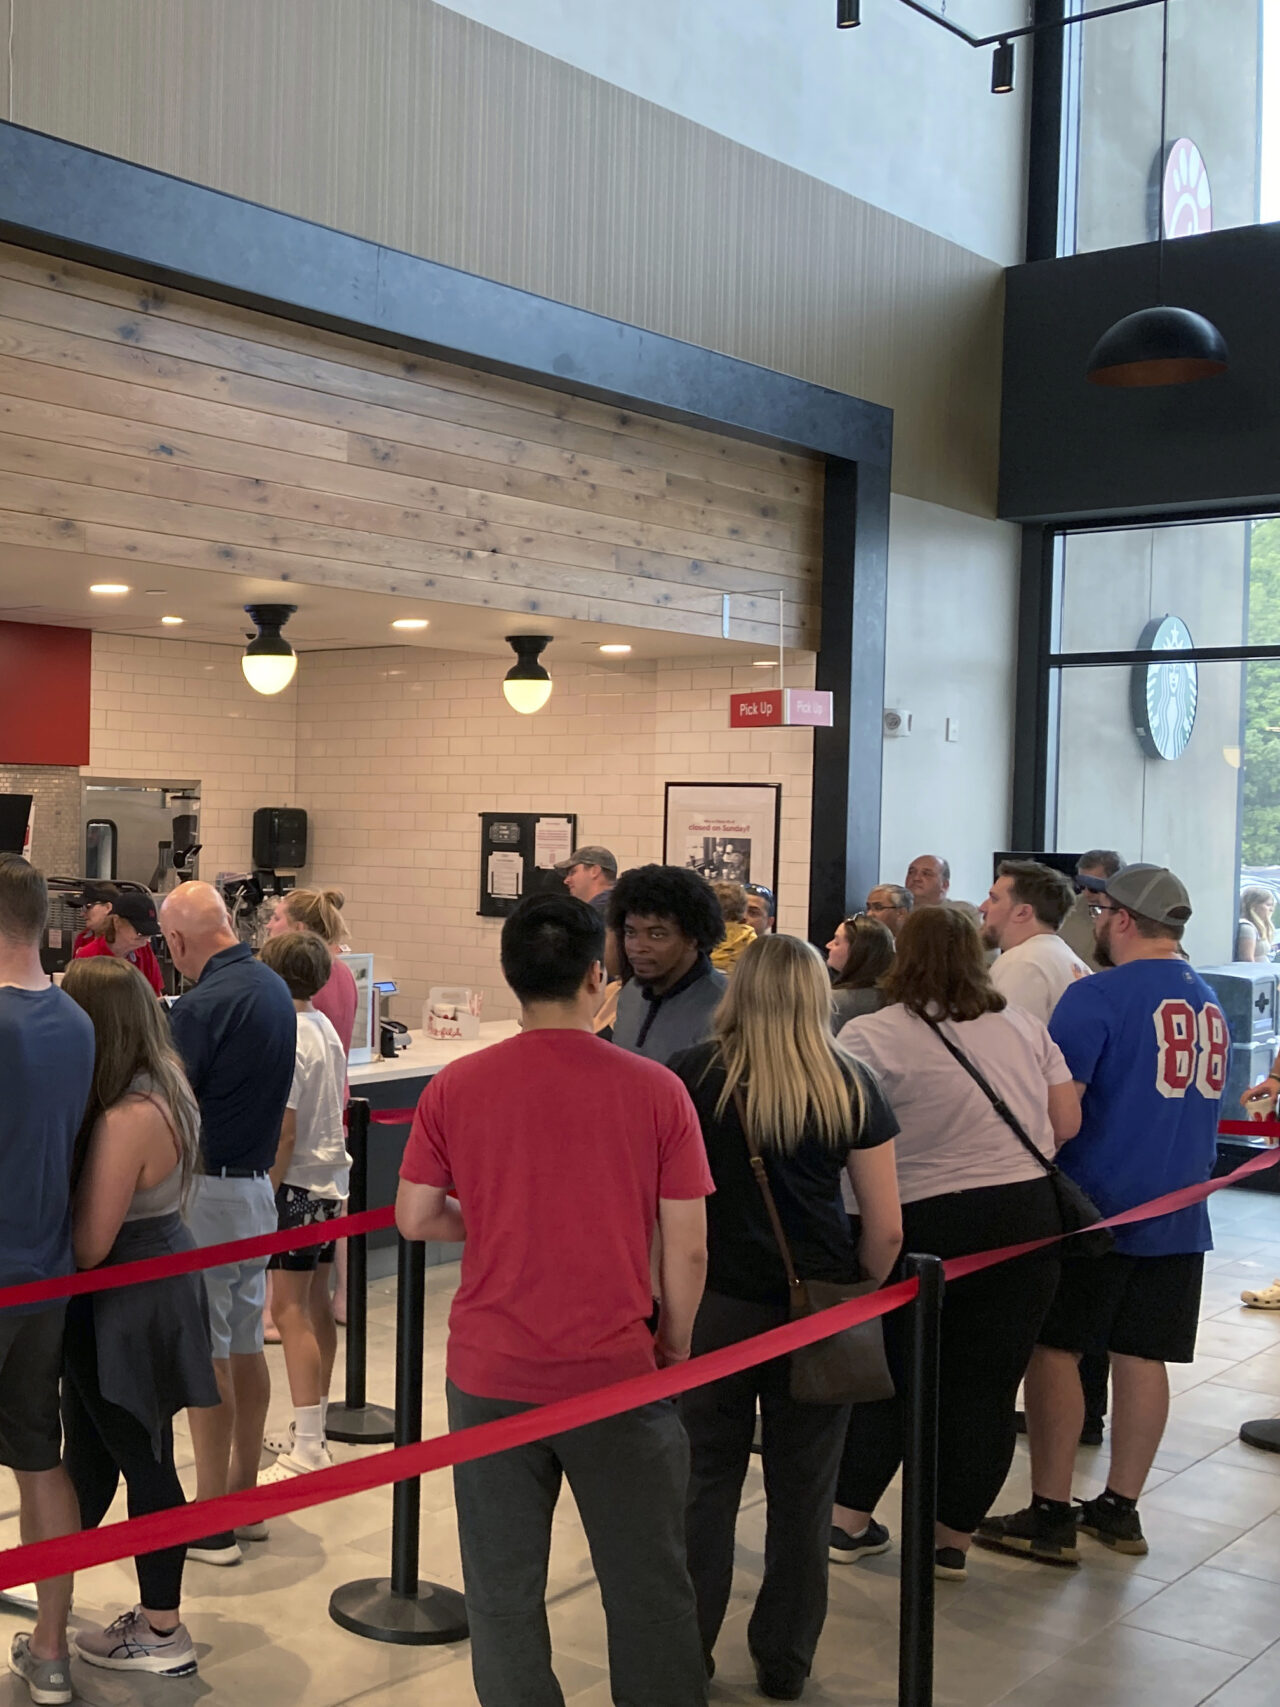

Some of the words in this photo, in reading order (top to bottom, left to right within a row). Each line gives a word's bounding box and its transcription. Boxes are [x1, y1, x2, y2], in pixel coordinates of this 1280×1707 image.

[740, 702, 759, 716] Pick
[760, 701, 773, 717] Up
[1153, 998, 1231, 1100] 88
